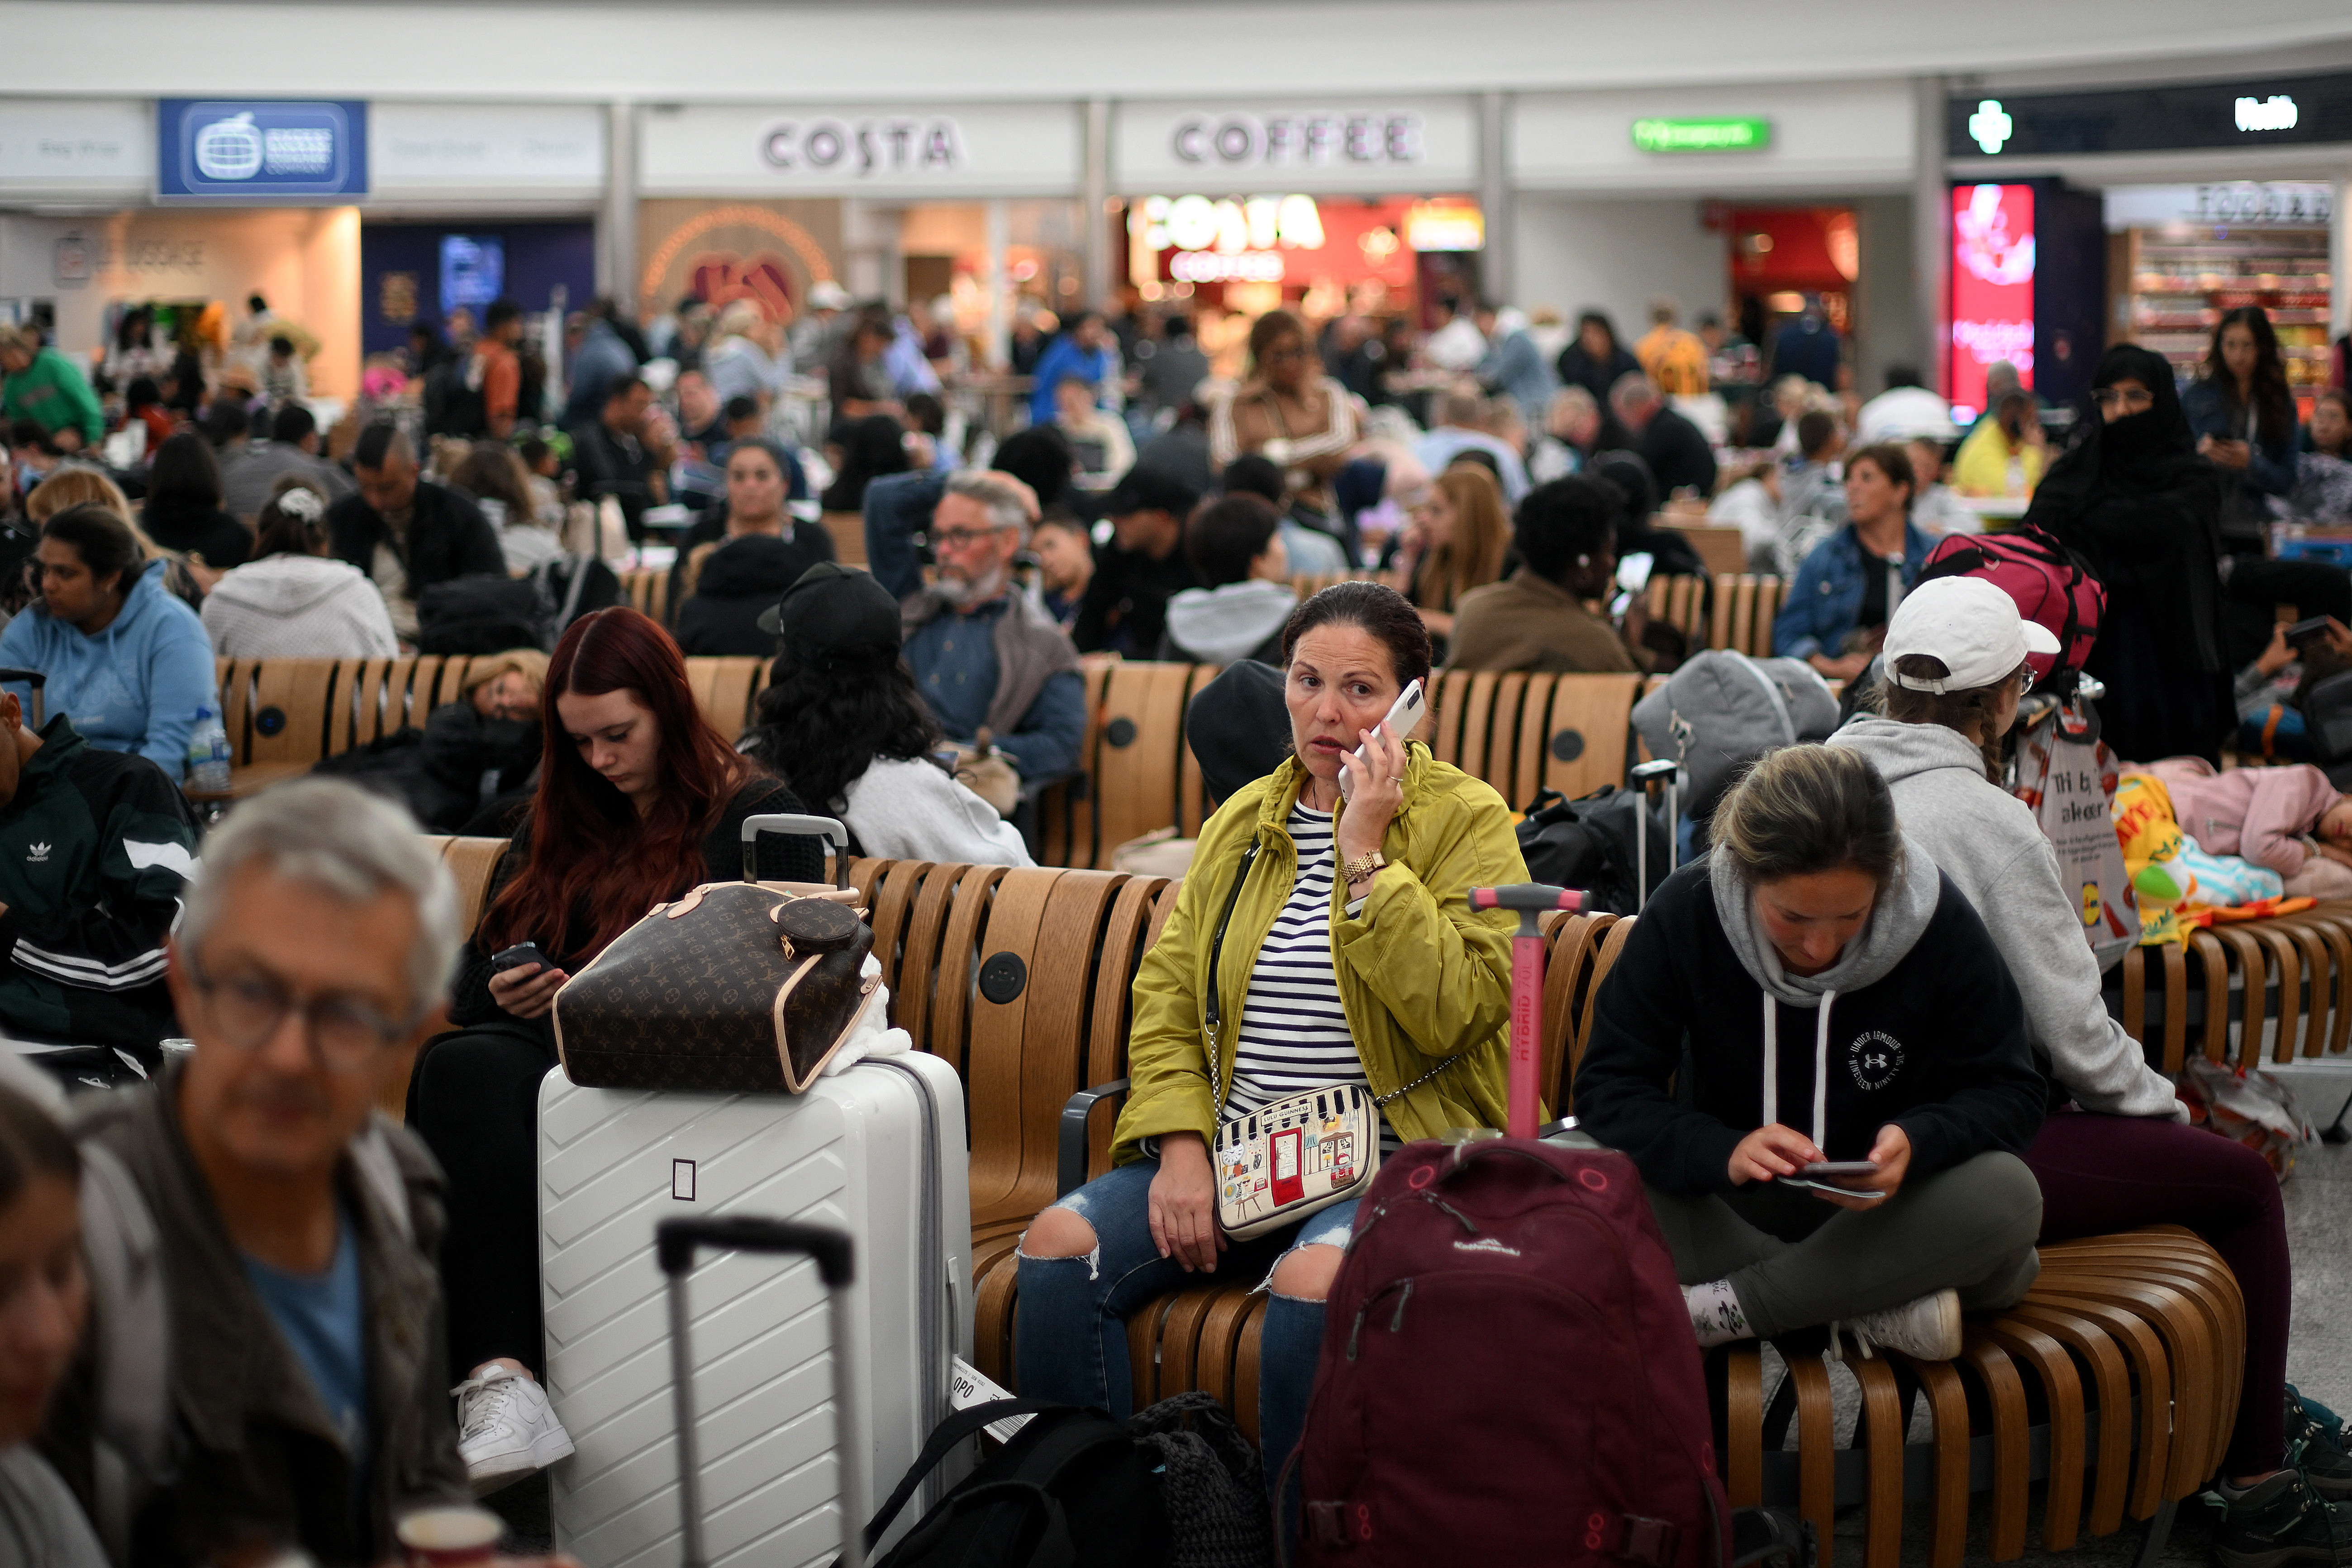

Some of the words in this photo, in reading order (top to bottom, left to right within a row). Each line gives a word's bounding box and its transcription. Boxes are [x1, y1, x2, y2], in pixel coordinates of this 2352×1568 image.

[762, 124, 956, 175] COSTA
[1175, 119, 1419, 162] COFFEE
[1850, 1032, 1871, 1053] UNDER
[1873, 1030, 1900, 1050] ARMOUR
[1848, 1060, 1871, 1090] NINETEEN
[1875, 1068, 1899, 1090] NINETY
[1279, 1106, 1309, 1117] GUINNESS
[953, 1377, 974, 1398] OPO
